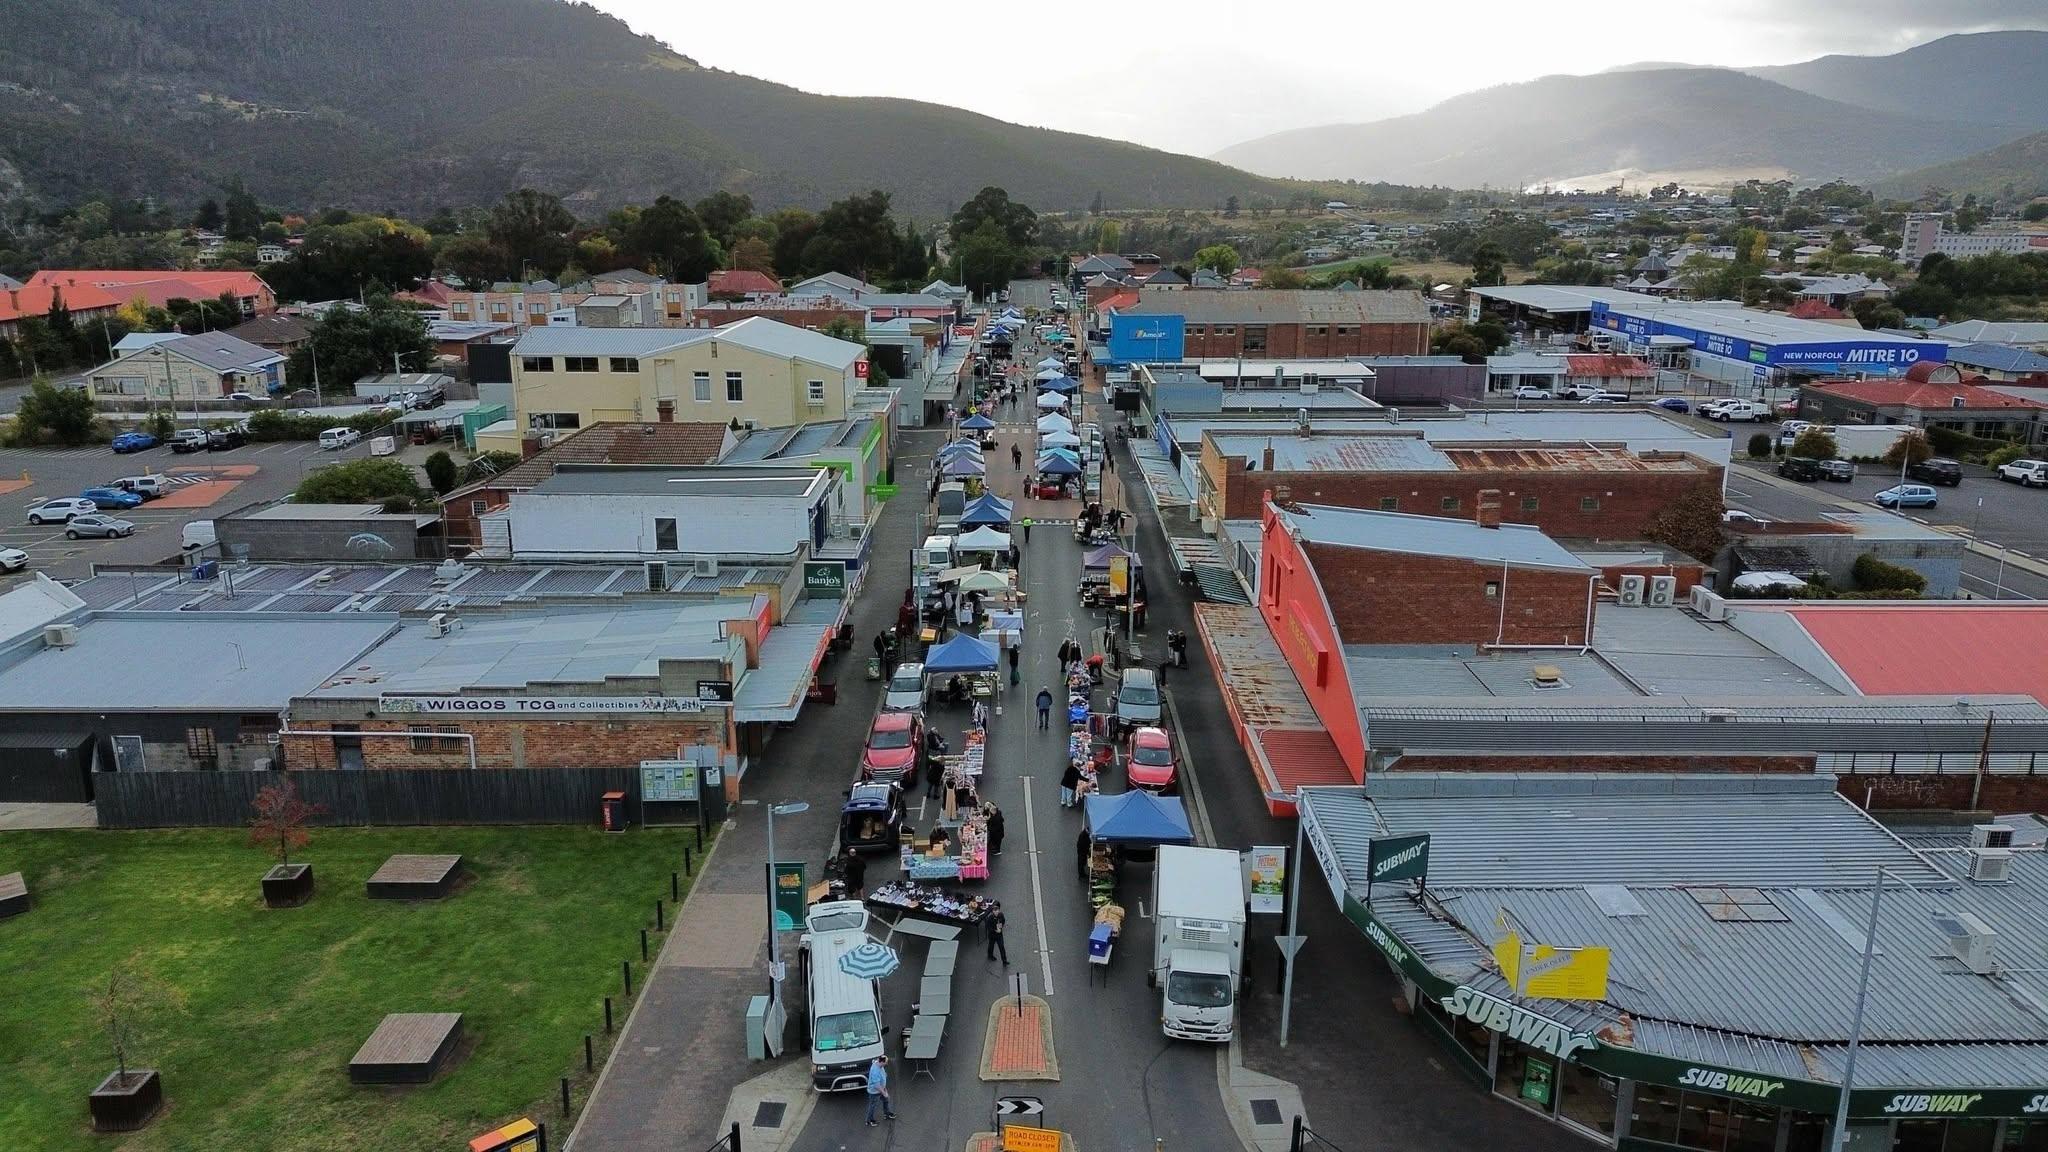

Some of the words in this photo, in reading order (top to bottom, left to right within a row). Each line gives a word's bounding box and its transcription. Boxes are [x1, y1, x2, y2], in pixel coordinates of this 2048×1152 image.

[1625, 323, 1638, 333] MITRE
[1707, 340, 1724, 353] MITRE
[1725, 344, 1733, 355] 10
[1846, 349, 1896, 362] MITRE
[1900, 349, 1919, 361] 10
[808, 576, 841, 586] Banjo's
[427, 700, 506, 709] WIGGOS
[516, 700, 556, 710] TCG
[557, 701, 576, 709] and
[579, 701, 639, 709] Collectibles
[1374, 841, 1427, 877] SUBWAY
[1366, 921, 1408, 963] SUBWAY
[1440, 985, 1600, 1060] SUBWAY
[1678, 1068, 1785, 1098] SUBWAY
[1884, 1094, 1982, 1112] SUBWAY
[1009, 1131, 1028, 1140] ROAD
[1028, 1133, 1056, 1142] CLOSED
